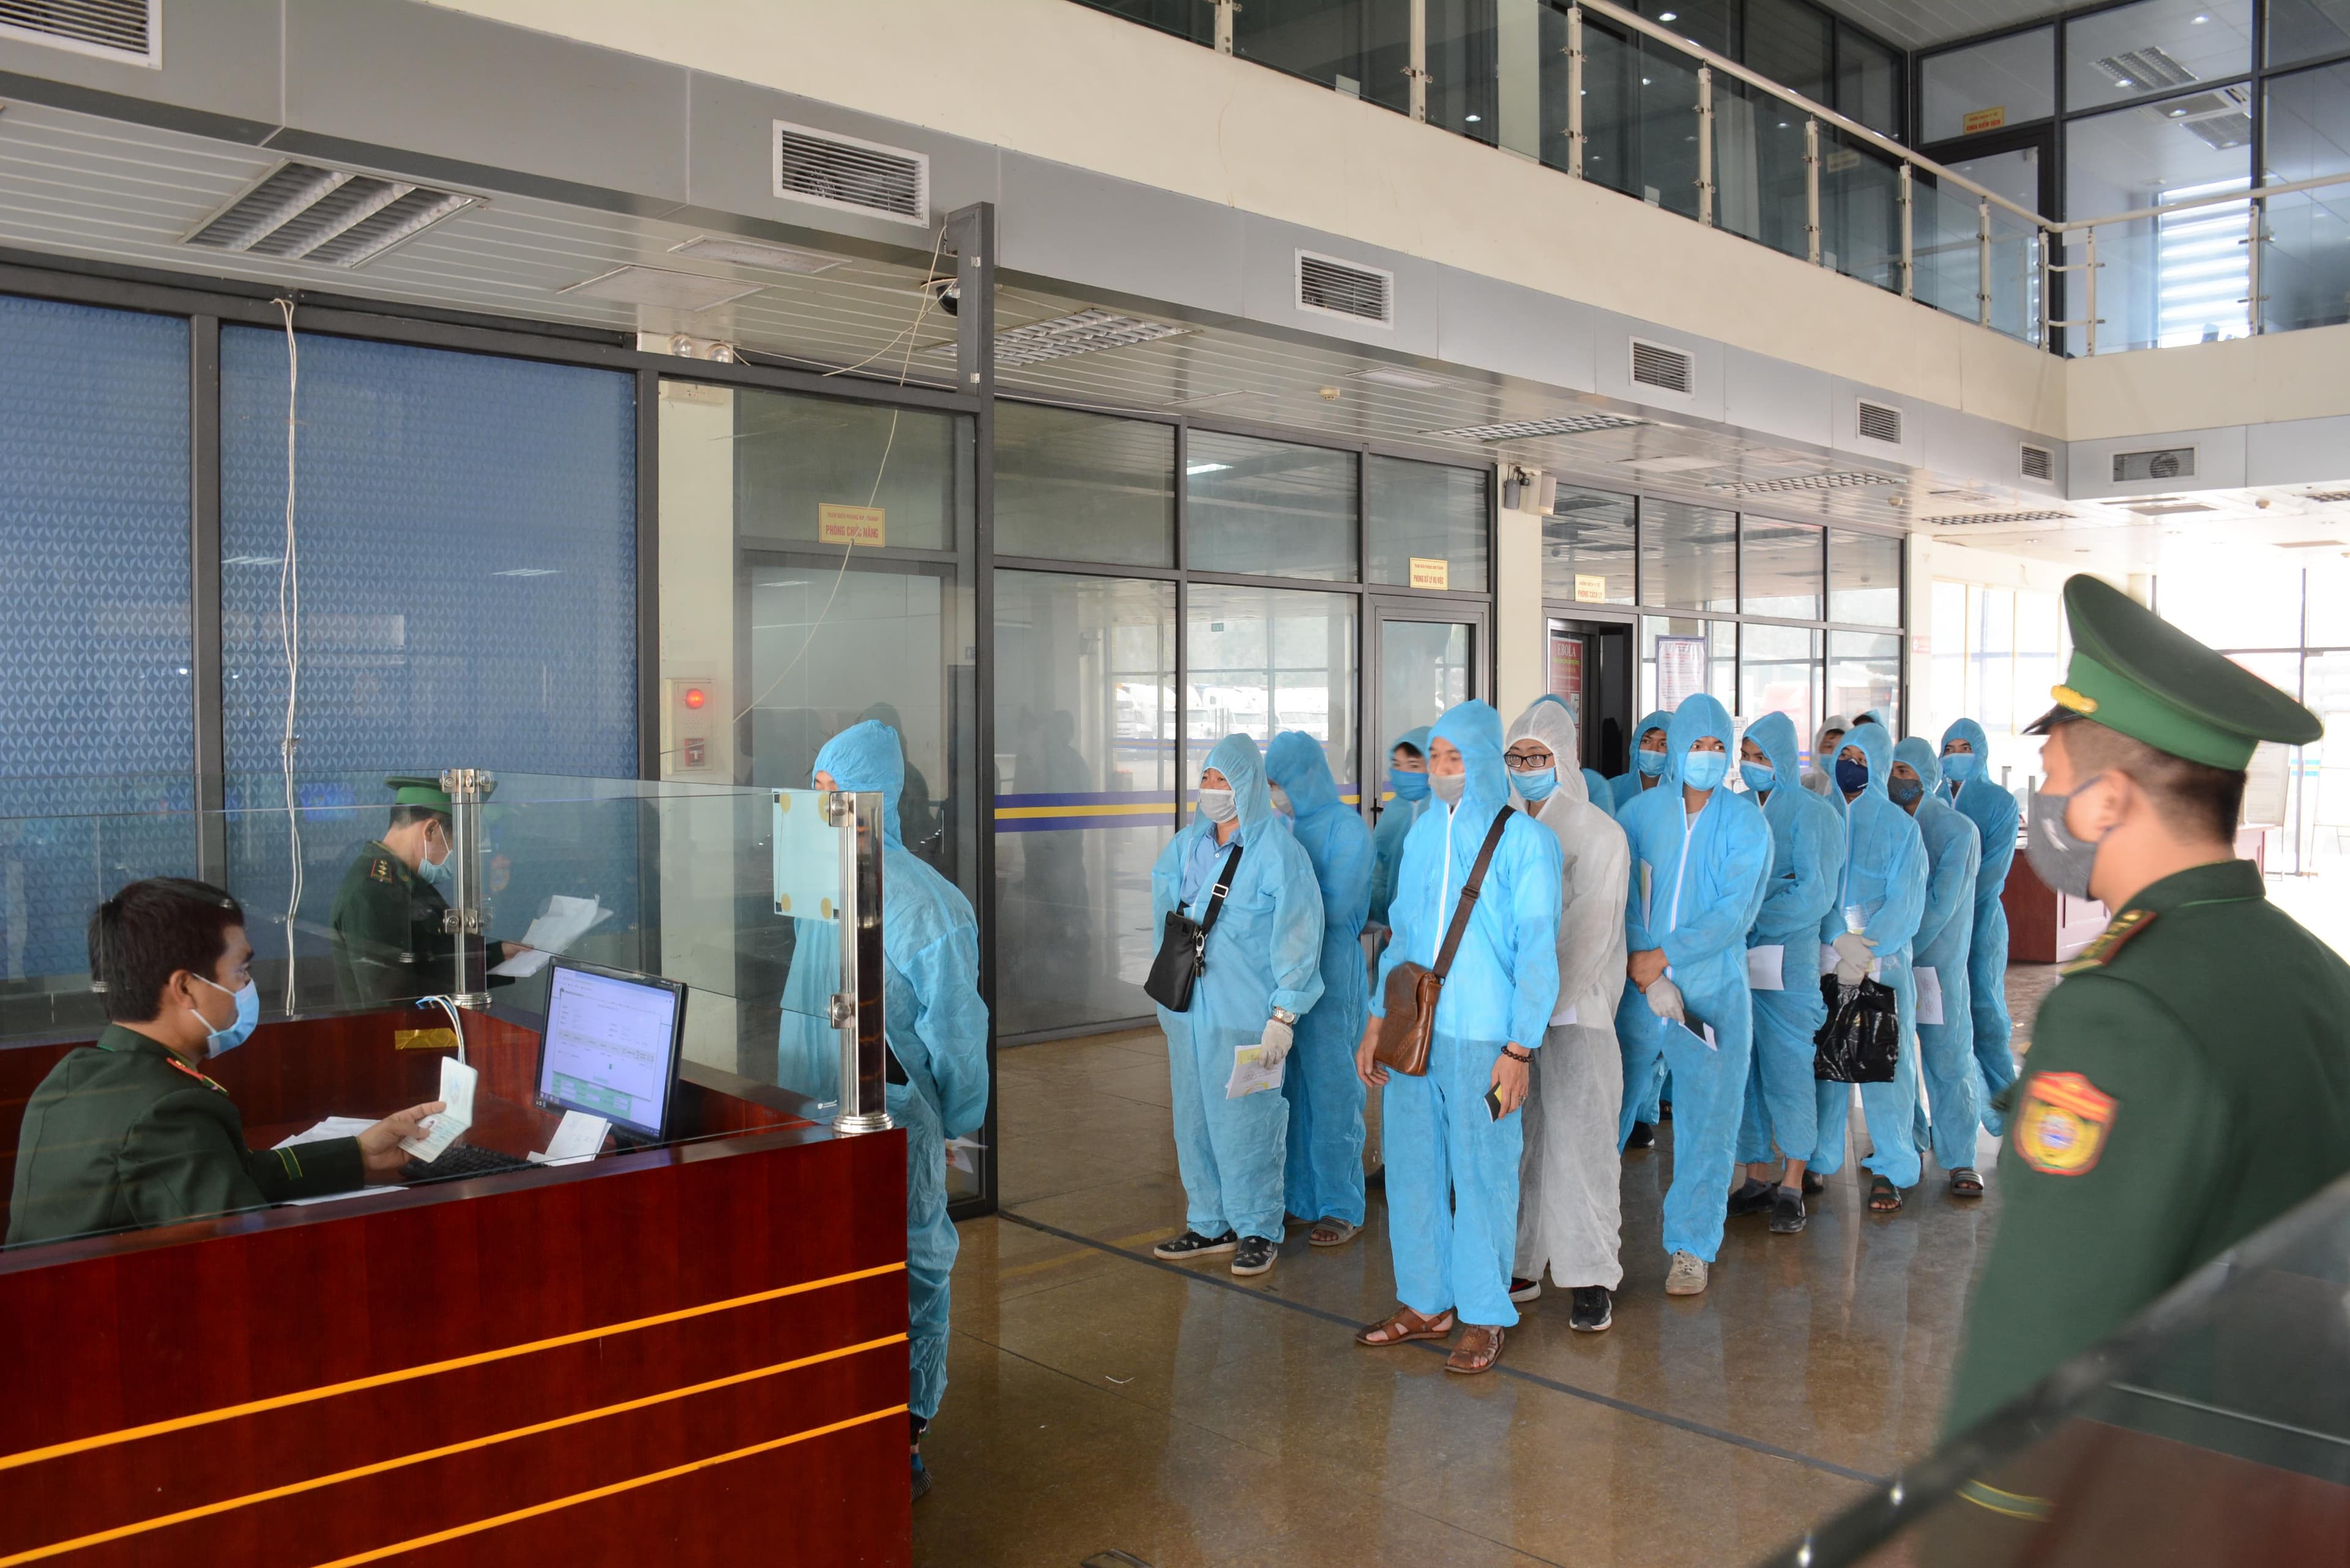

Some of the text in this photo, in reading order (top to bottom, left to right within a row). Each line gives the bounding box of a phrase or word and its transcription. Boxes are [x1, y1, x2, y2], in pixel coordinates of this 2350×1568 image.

[826, 523, 845, 536] PHÒNG
[864, 526, 878, 539] NĂNG
[1414, 574, 1423, 583] PHÒNG
[1557, 643, 1576, 657] EBOLA
